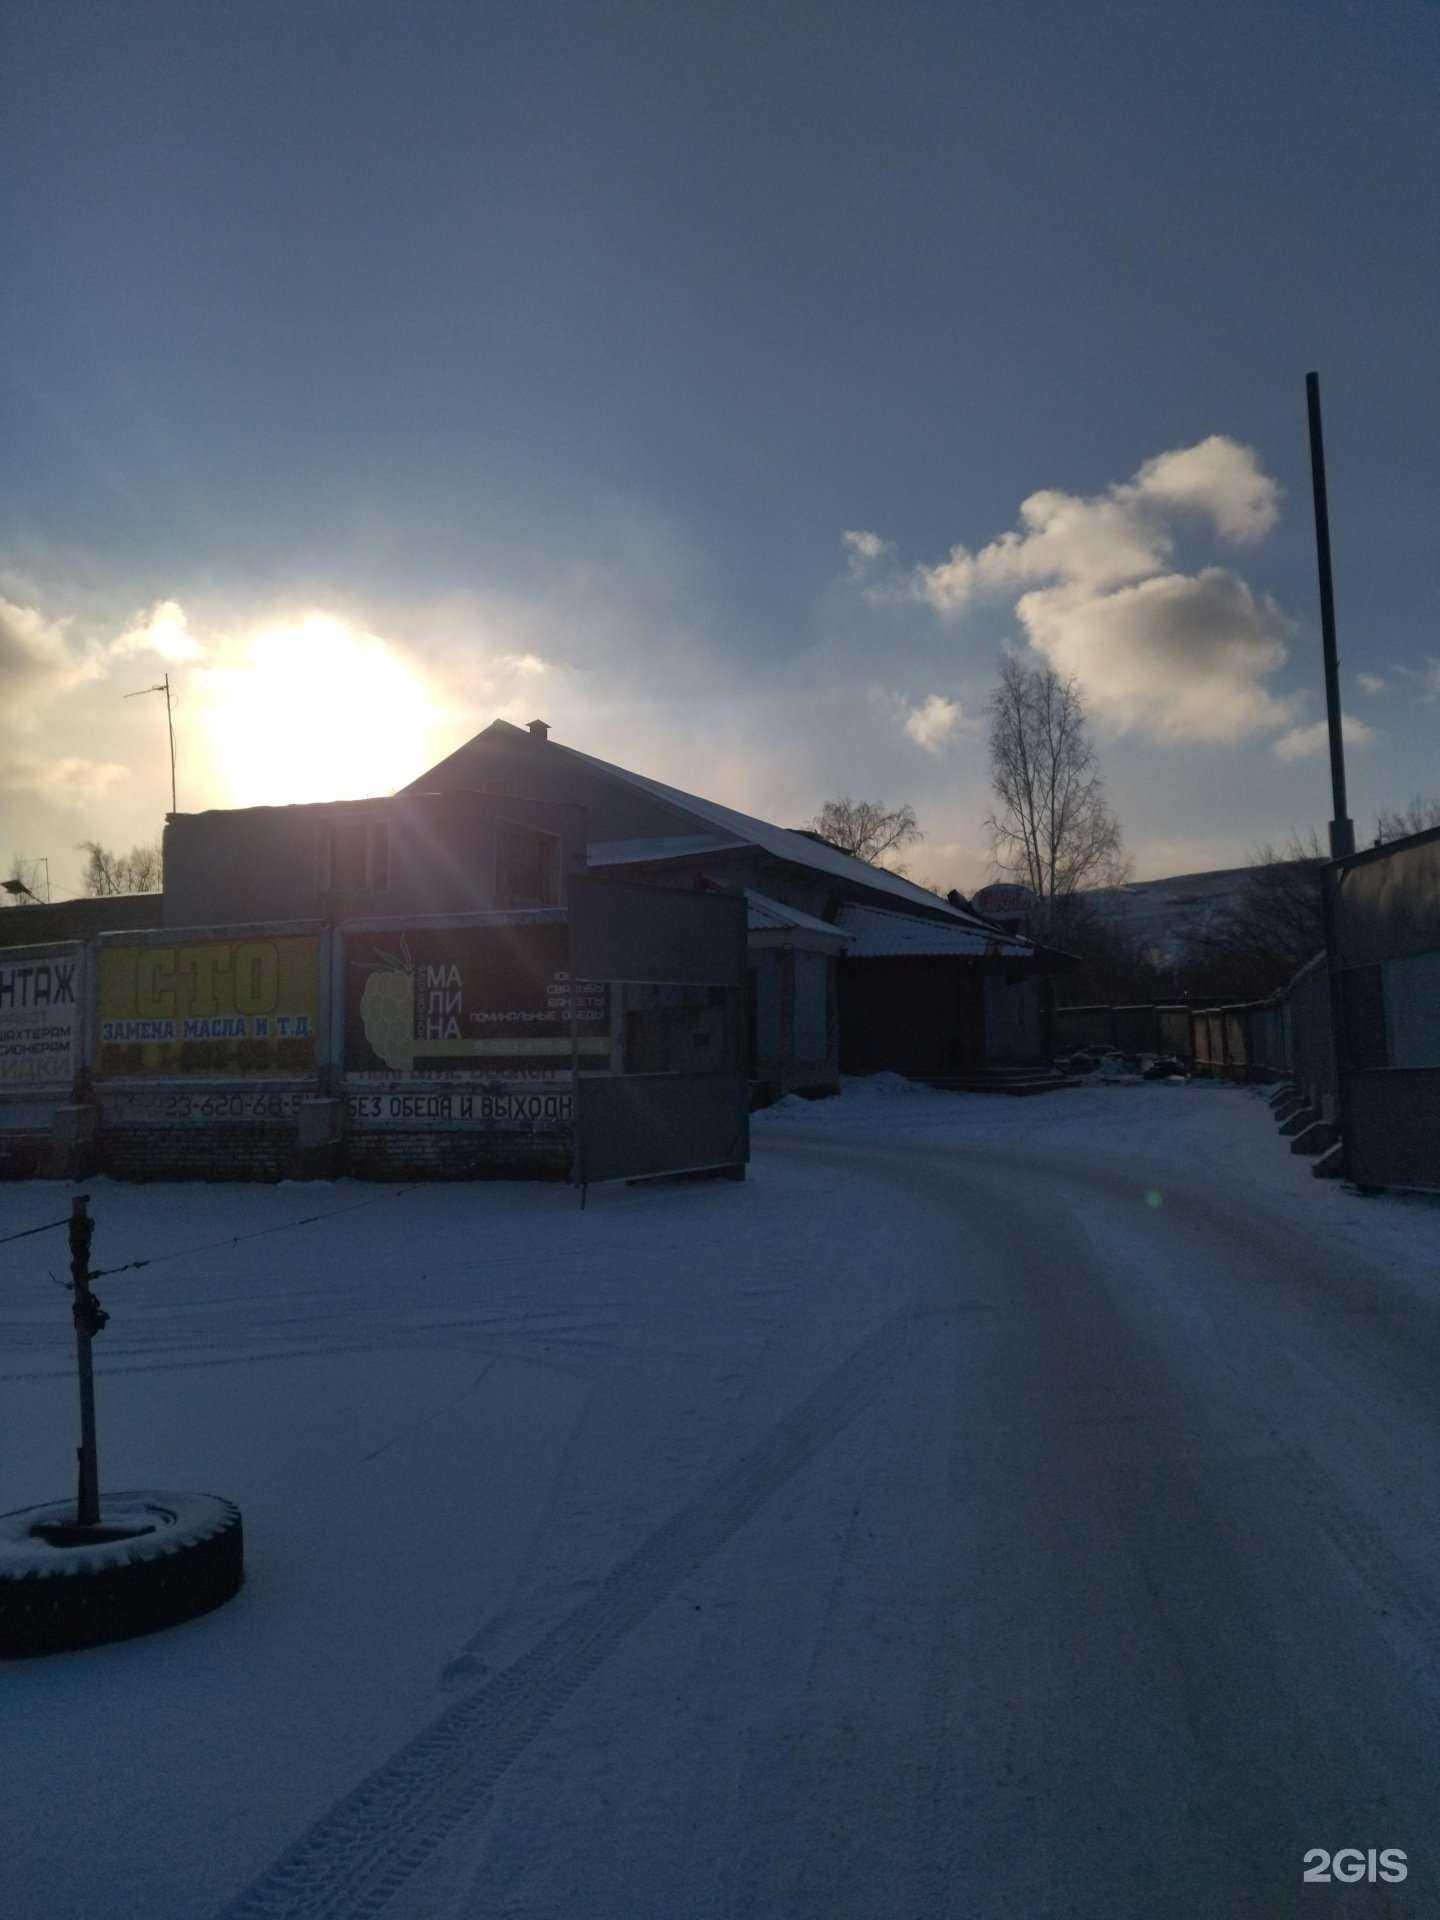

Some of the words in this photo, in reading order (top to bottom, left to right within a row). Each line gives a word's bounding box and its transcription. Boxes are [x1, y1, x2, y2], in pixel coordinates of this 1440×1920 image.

[135, 944, 279, 1018] СТО
[561, 1009, 606, 1021] ОЕДЫ
[102, 1020, 174, 1040] ЗАМЕНА
[184, 1018, 246, 1038] МАСЛА
[255, 1017, 268, 1036] И
[389, 1096, 452, 1118] ОБЕДА
